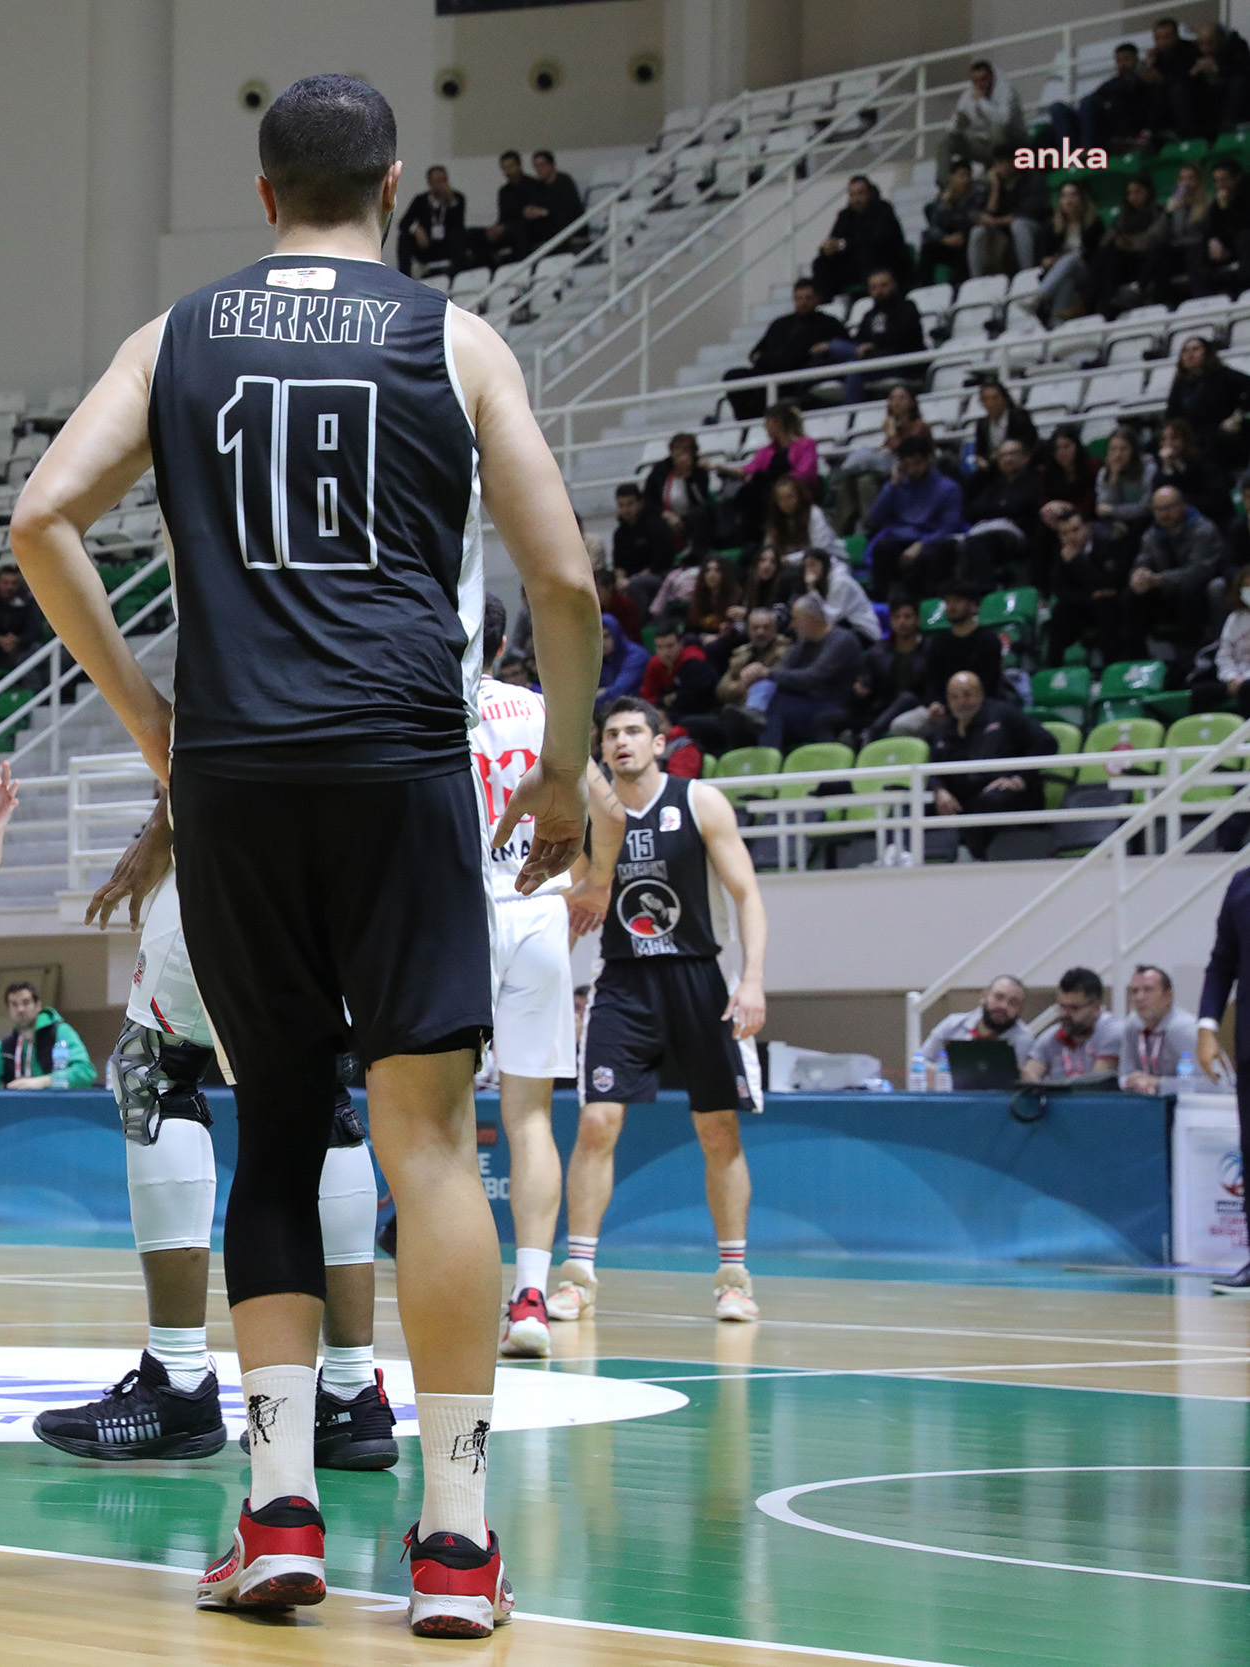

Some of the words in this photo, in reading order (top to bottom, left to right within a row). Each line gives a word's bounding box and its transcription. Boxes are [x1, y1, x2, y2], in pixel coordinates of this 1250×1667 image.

[209, 290, 401, 345] BERKAY
[217, 375, 378, 570] 18
[626, 828, 655, 861] 15
